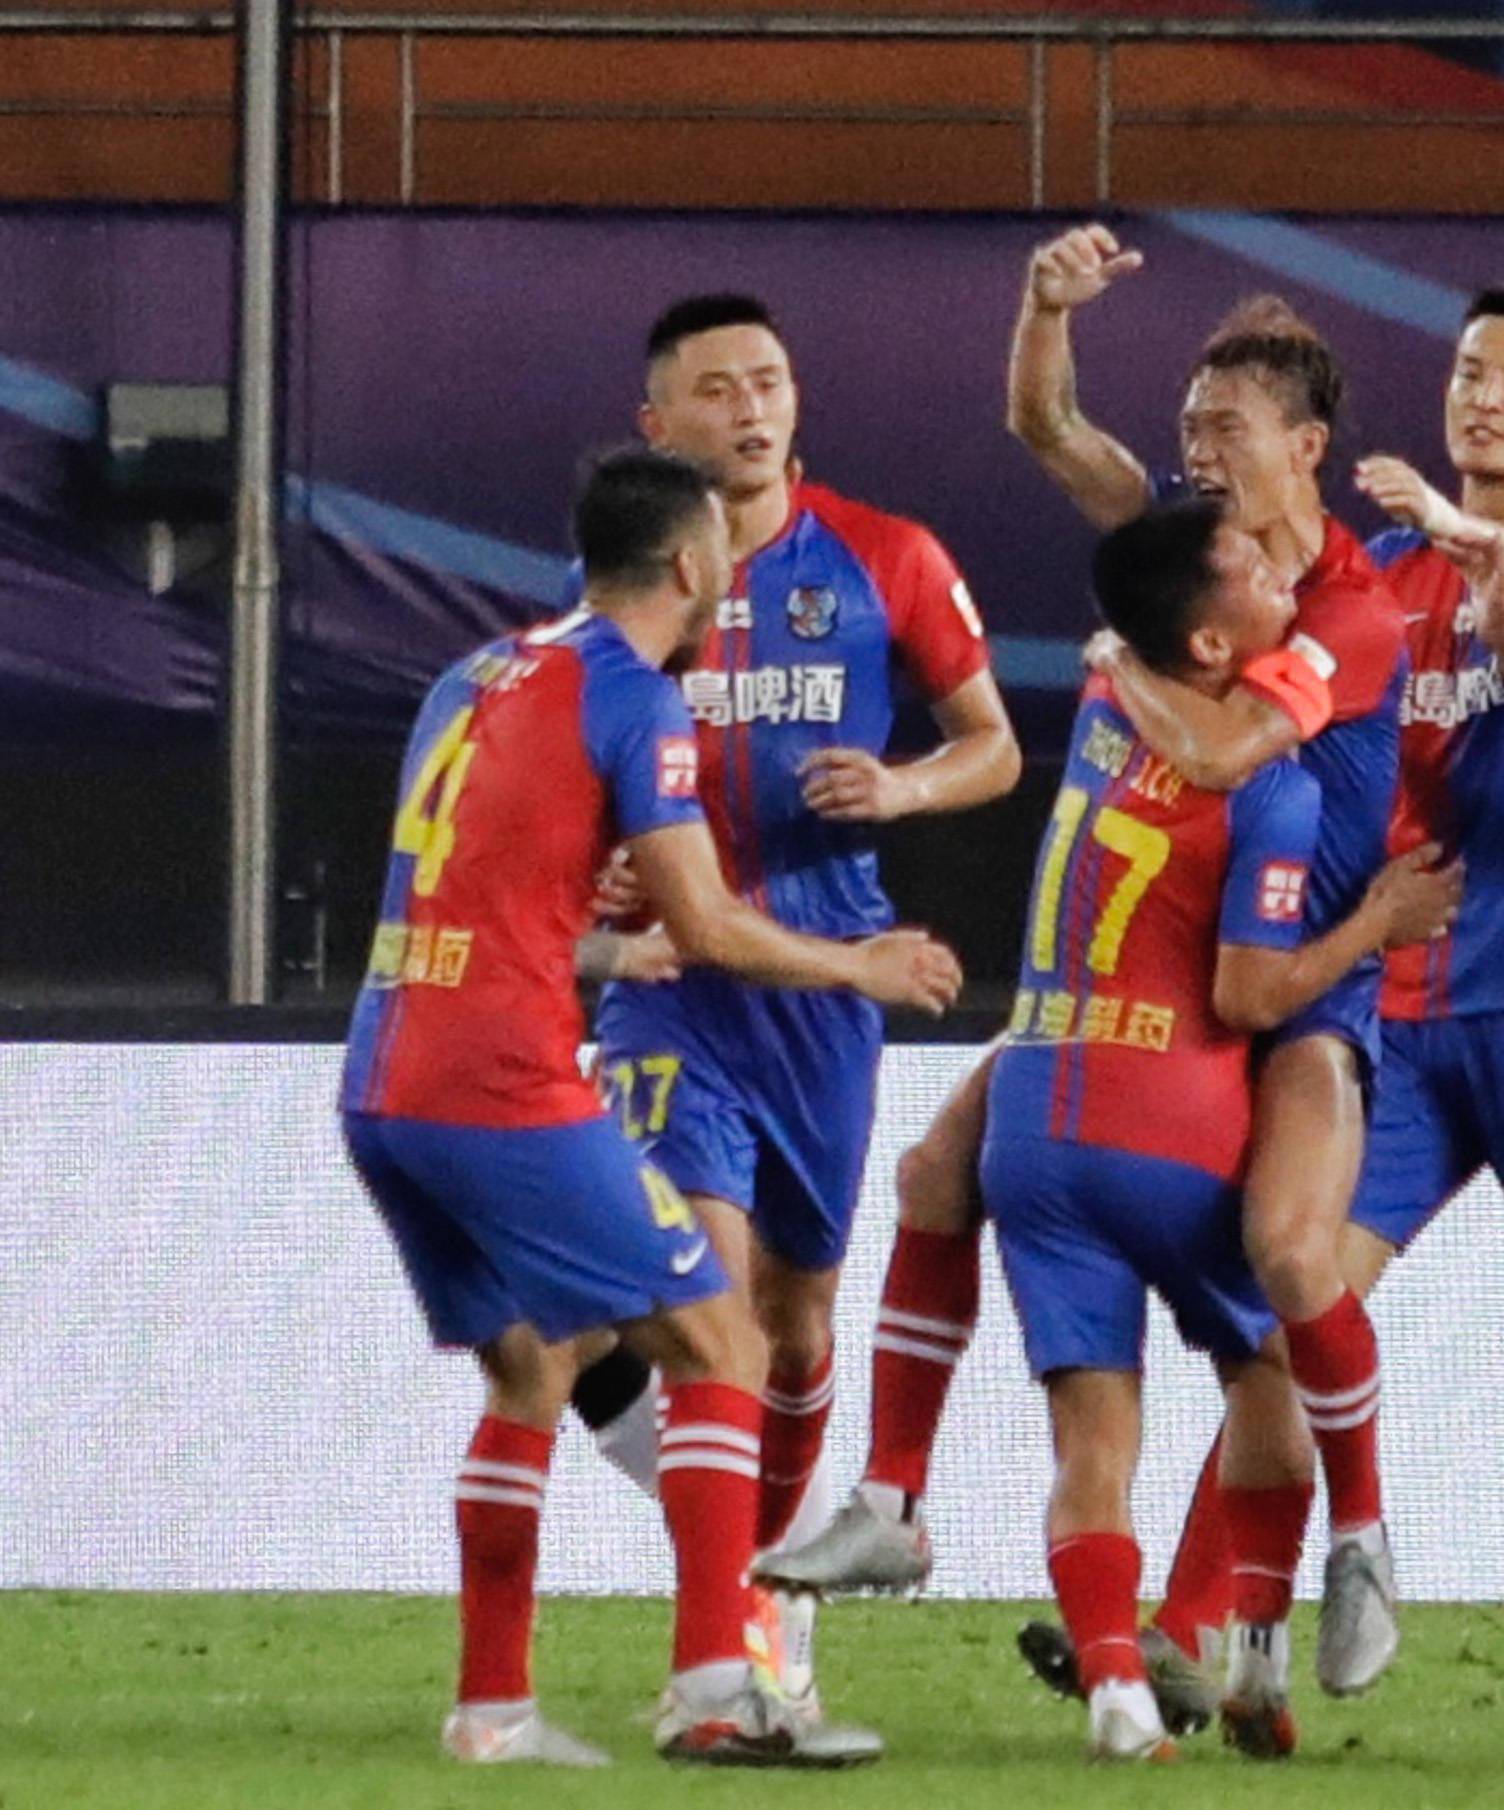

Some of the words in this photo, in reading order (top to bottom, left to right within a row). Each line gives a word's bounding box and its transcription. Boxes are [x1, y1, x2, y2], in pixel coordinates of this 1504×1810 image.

[393, 704, 479, 897] 4
[1031, 786, 1172, 977] 17
[639, 1164, 697, 1236] 4
